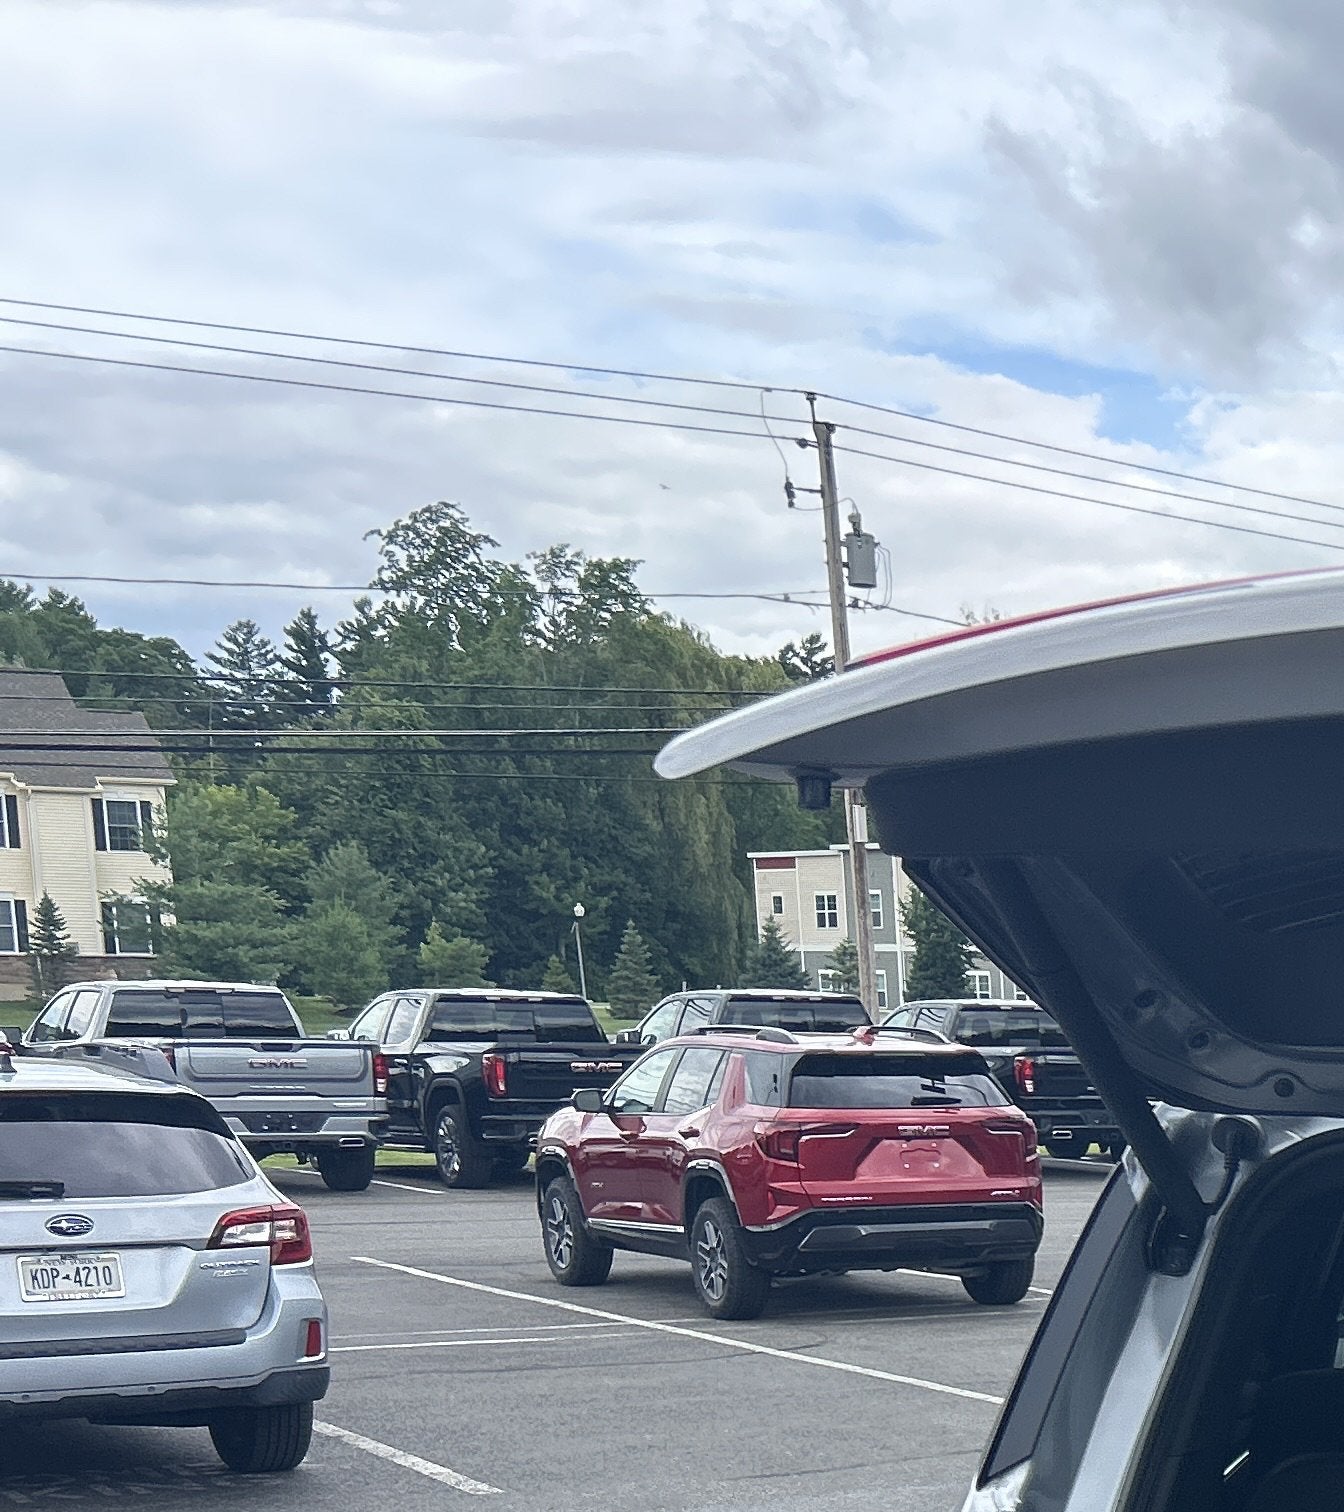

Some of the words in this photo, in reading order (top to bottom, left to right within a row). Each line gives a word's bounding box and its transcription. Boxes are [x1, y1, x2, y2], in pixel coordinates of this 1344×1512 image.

[247, 1058, 308, 1069] GMC
[570, 1062, 623, 1073] GMC
[897, 1125, 950, 1136] GMC
[29, 1267, 60, 1290] KDP
[73, 1265, 113, 1288] 4210
